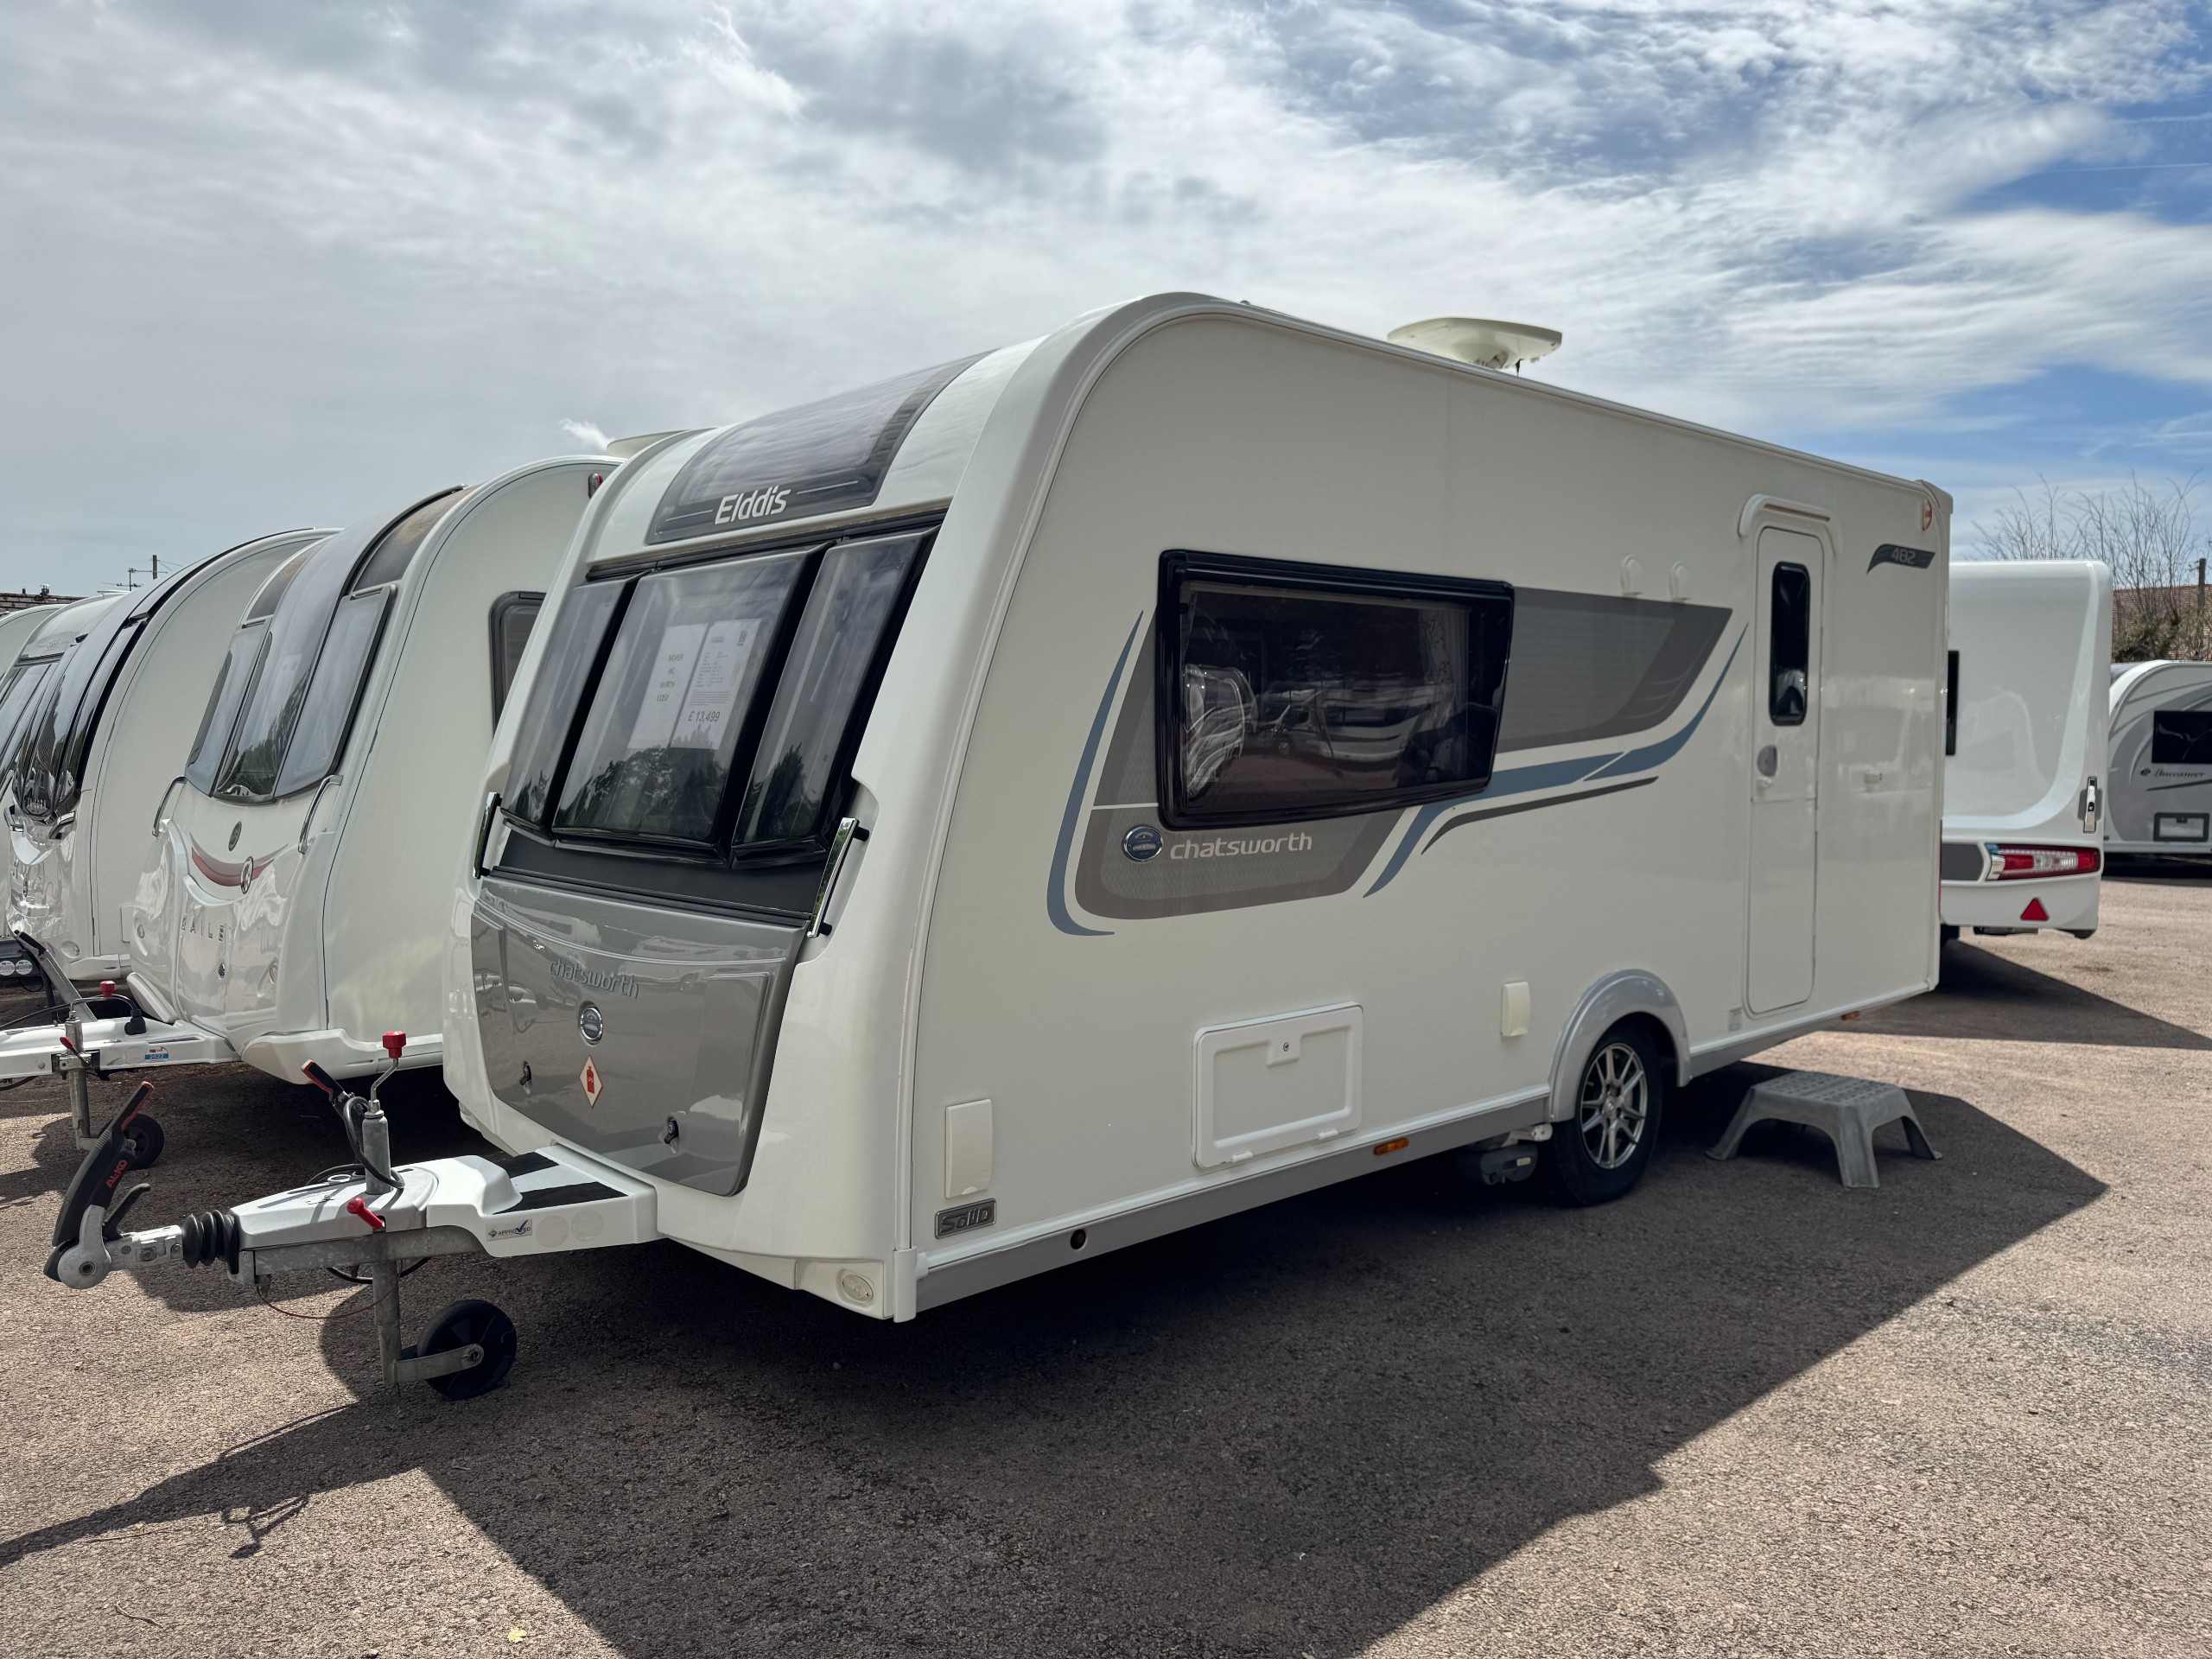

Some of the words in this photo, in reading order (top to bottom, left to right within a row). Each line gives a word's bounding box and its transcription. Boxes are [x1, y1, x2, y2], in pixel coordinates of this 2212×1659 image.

[715, 485, 792, 525] Elddis
[1891, 547, 1916, 565] 482
[688, 711, 696, 722] £
[696, 710, 721, 724] 13,499
[1170, 831, 1313, 860] chatsworth
[549, 958, 639, 999] chatsworth
